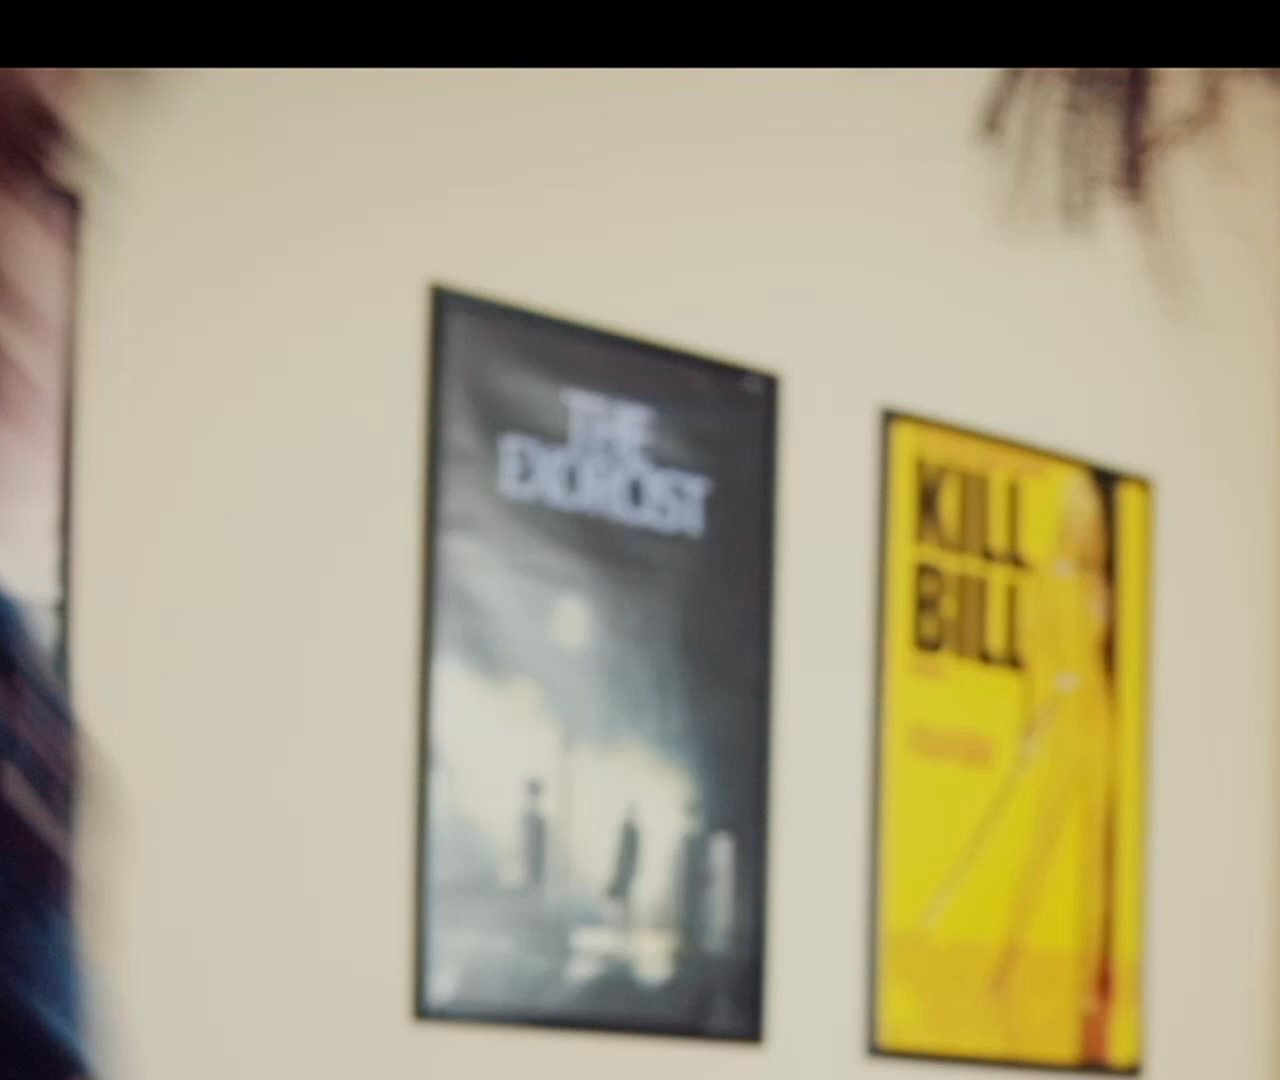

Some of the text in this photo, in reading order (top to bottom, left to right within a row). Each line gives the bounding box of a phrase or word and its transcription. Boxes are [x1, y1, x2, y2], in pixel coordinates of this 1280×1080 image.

[558, 384, 657, 456] THE
[914, 456, 1032, 572] KILL
[912, 559, 1028, 672] BILL
